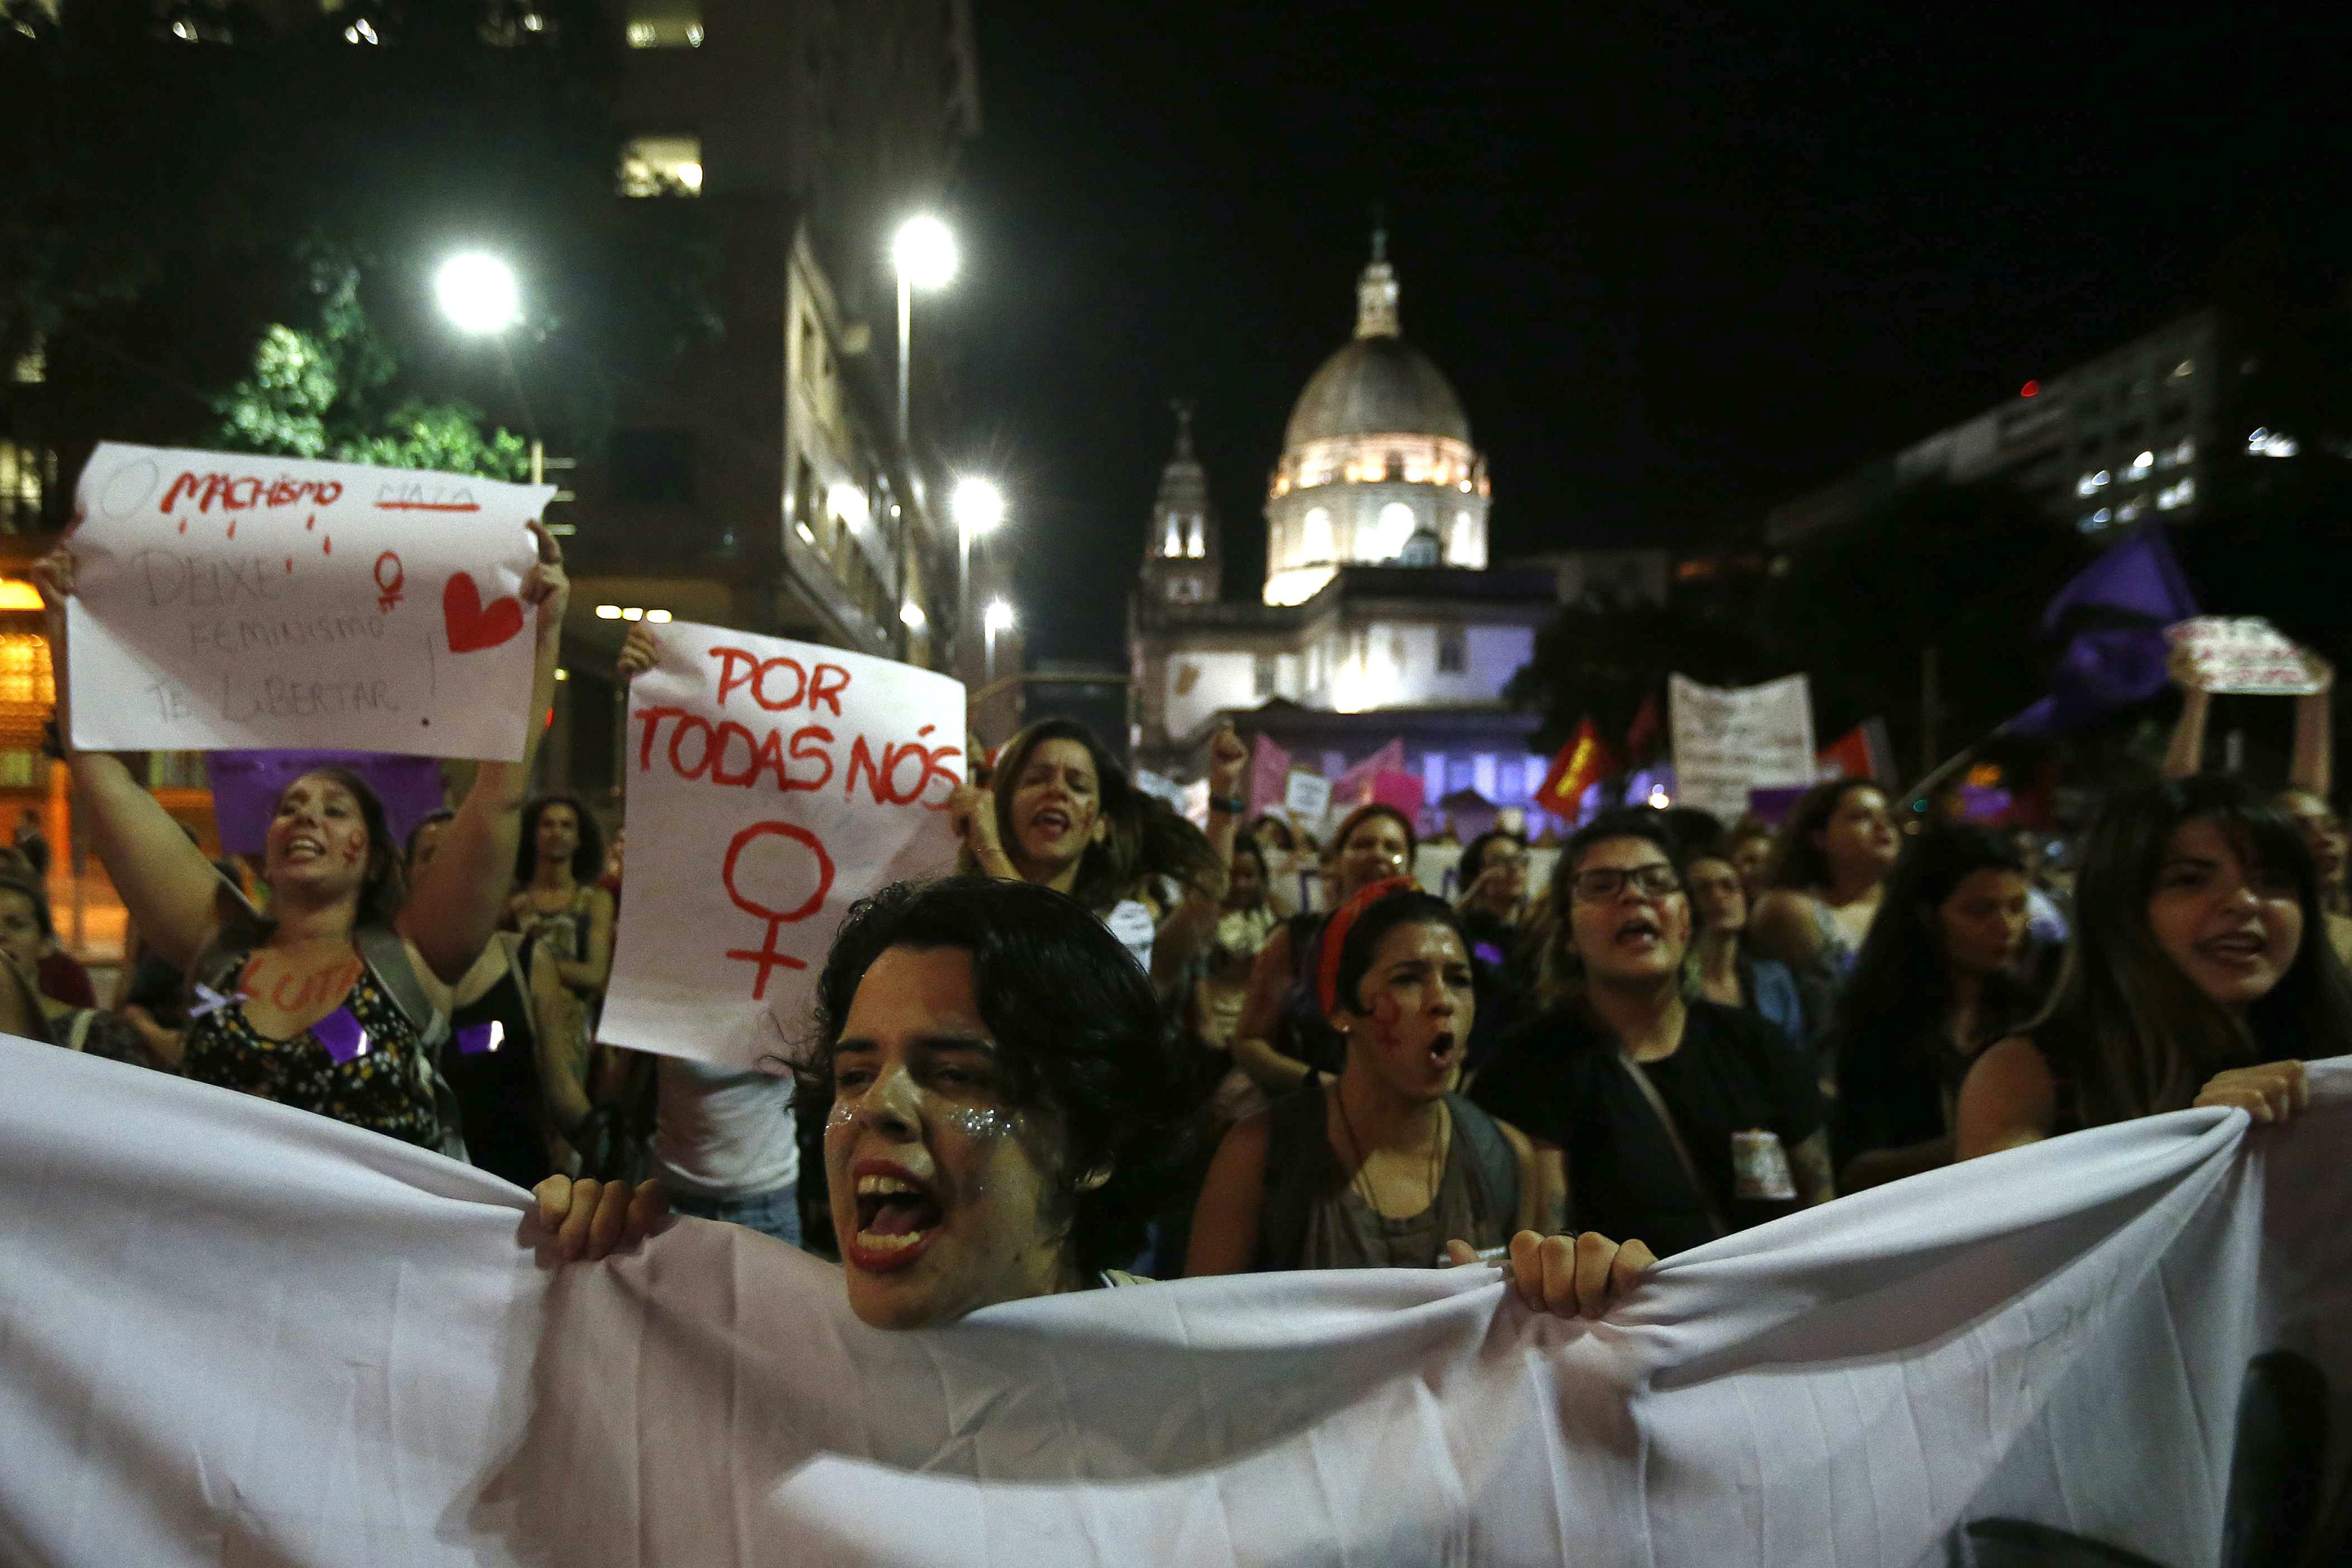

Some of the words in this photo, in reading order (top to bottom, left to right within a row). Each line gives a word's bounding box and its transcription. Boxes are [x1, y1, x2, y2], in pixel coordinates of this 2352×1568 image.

[100, 458, 159, 521] O
[709, 646, 851, 717] POR
[635, 706, 835, 792] TODAS
[844, 724, 962, 812] NÓS
